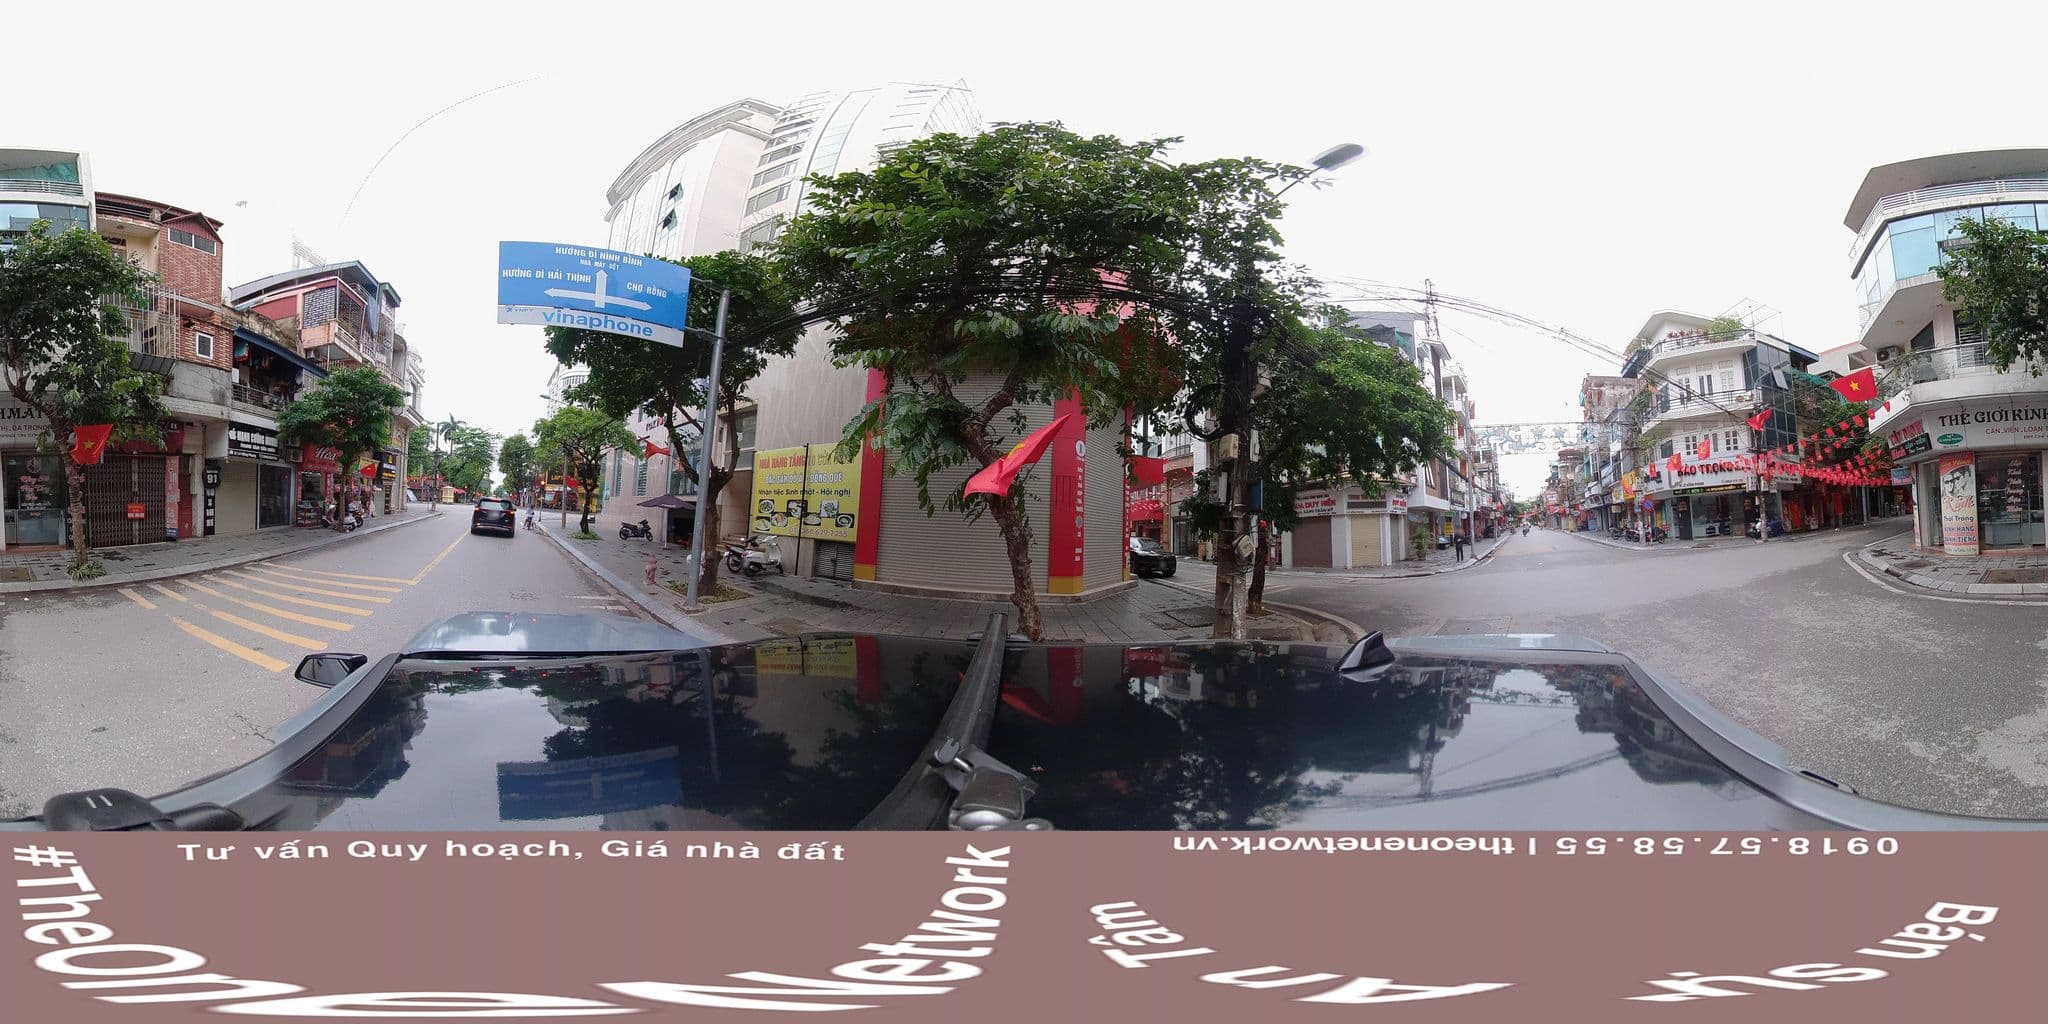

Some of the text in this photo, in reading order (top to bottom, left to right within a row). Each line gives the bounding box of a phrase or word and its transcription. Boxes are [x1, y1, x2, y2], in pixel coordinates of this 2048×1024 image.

[542, 309, 653, 337] vinaphone
[1938, 407, 1971, 427] THẾ
[1974, 406, 2011, 423] GIỚI
[207, 474, 218, 484] 91
